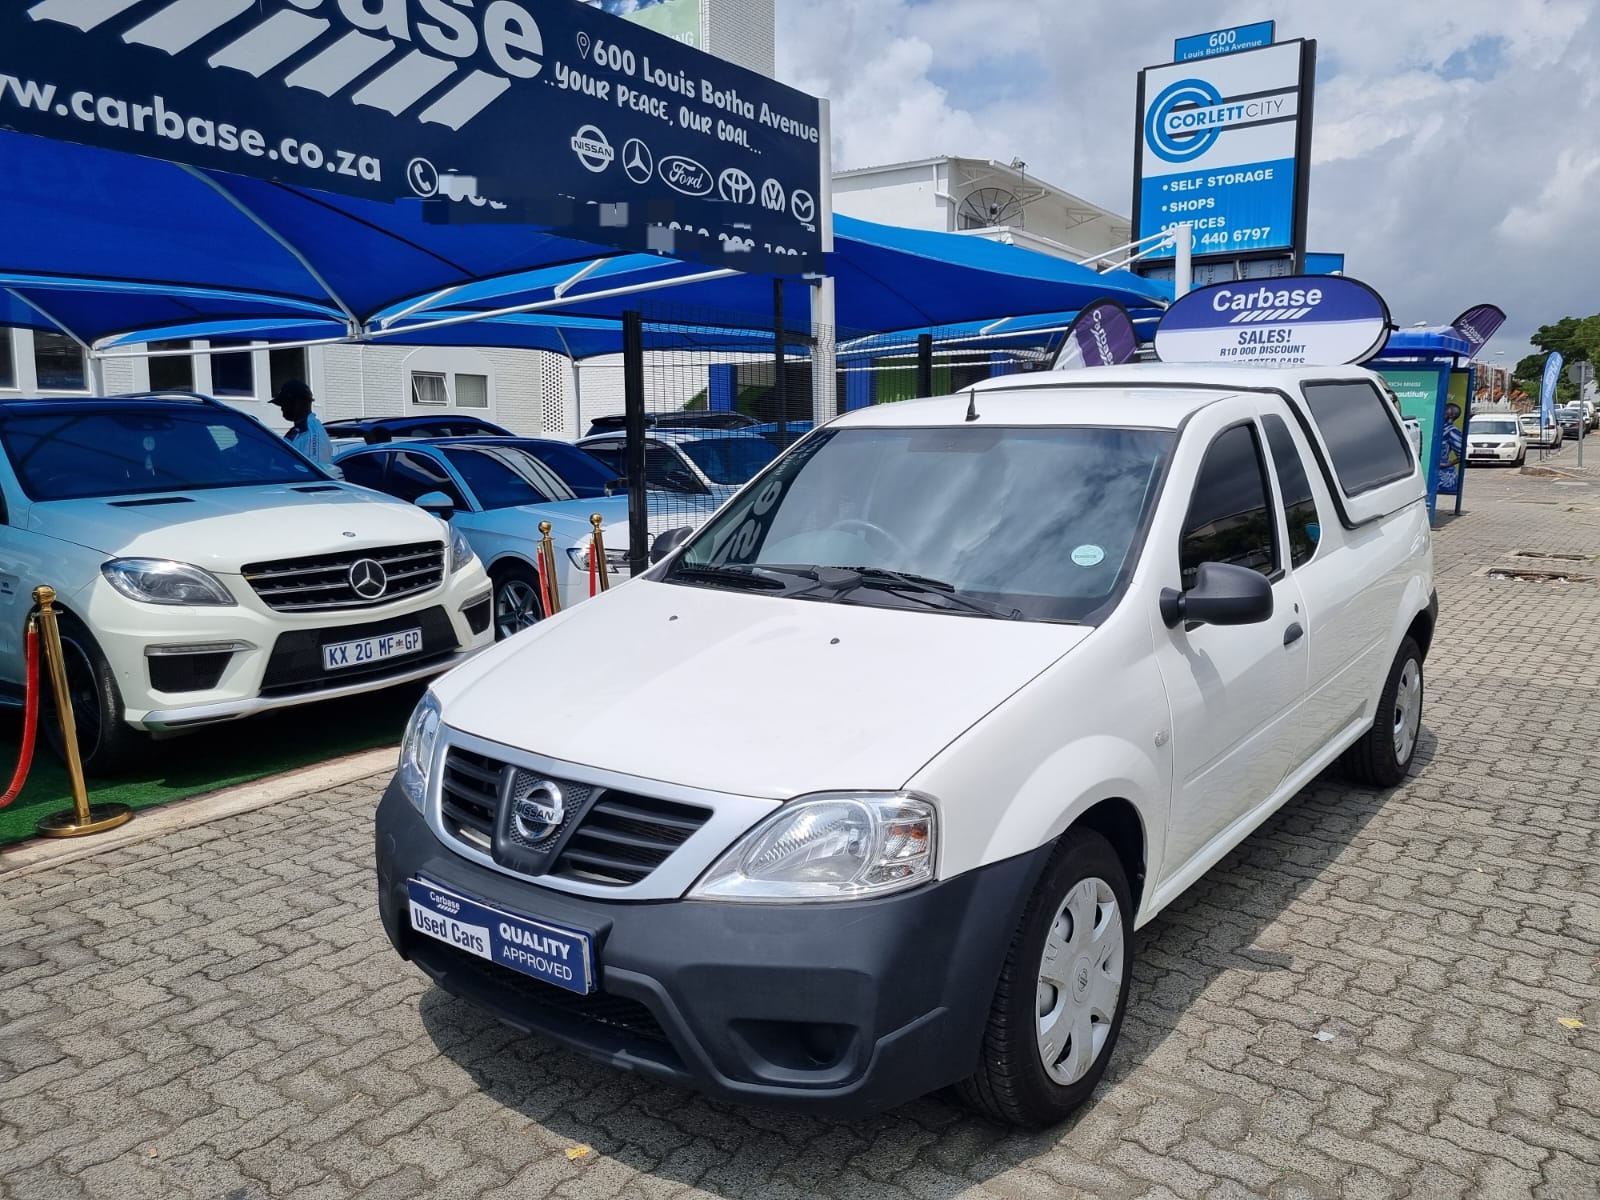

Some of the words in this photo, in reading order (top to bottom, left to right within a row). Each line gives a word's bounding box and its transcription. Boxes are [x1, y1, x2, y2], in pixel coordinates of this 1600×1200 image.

[1183, 51, 1204, 60] Louis
[1206, 46, 1230, 56] Botha
[1231, 40, 1263, 51] Avenue
[1209, 30, 1237, 47] 600
[593, 40, 636, 76] 600
[643, 57, 696, 98] Louis
[702, 79, 754, 120] Botha
[759, 103, 819, 143] Avenue
[0, 74, 382, 181] w.carbase.co.za
[680, 107, 712, 135] OUR
[574, 139, 612, 157] NISSAN
[668, 161, 704, 190] Ford
[1170, 178, 1203, 192] SELF
[1207, 169, 1274, 187] STORAGE
[1169, 198, 1216, 213] SHOPS
[1201, 231, 1228, 245] 440
[1233, 227, 1271, 242] 6797
[1213, 287, 1323, 312] Carbase
[1238, 329, 1292, 346] SALES!
[1219, 348, 1238, 357] R10
[1239, 346, 1257, 355] 000
[1259, 345, 1307, 355] DISCOUNT
[329, 646, 349, 666] KX
[355, 642, 373, 661] 20
[379, 637, 394, 657] MF
[404, 632, 419, 650] GP
[429, 891, 460, 911] Carbase
[415, 908, 448, 939] Used
[451, 922, 484, 953] Cars
[499, 922, 571, 960] QUALITY
[503, 945, 573, 981] APPROVED
